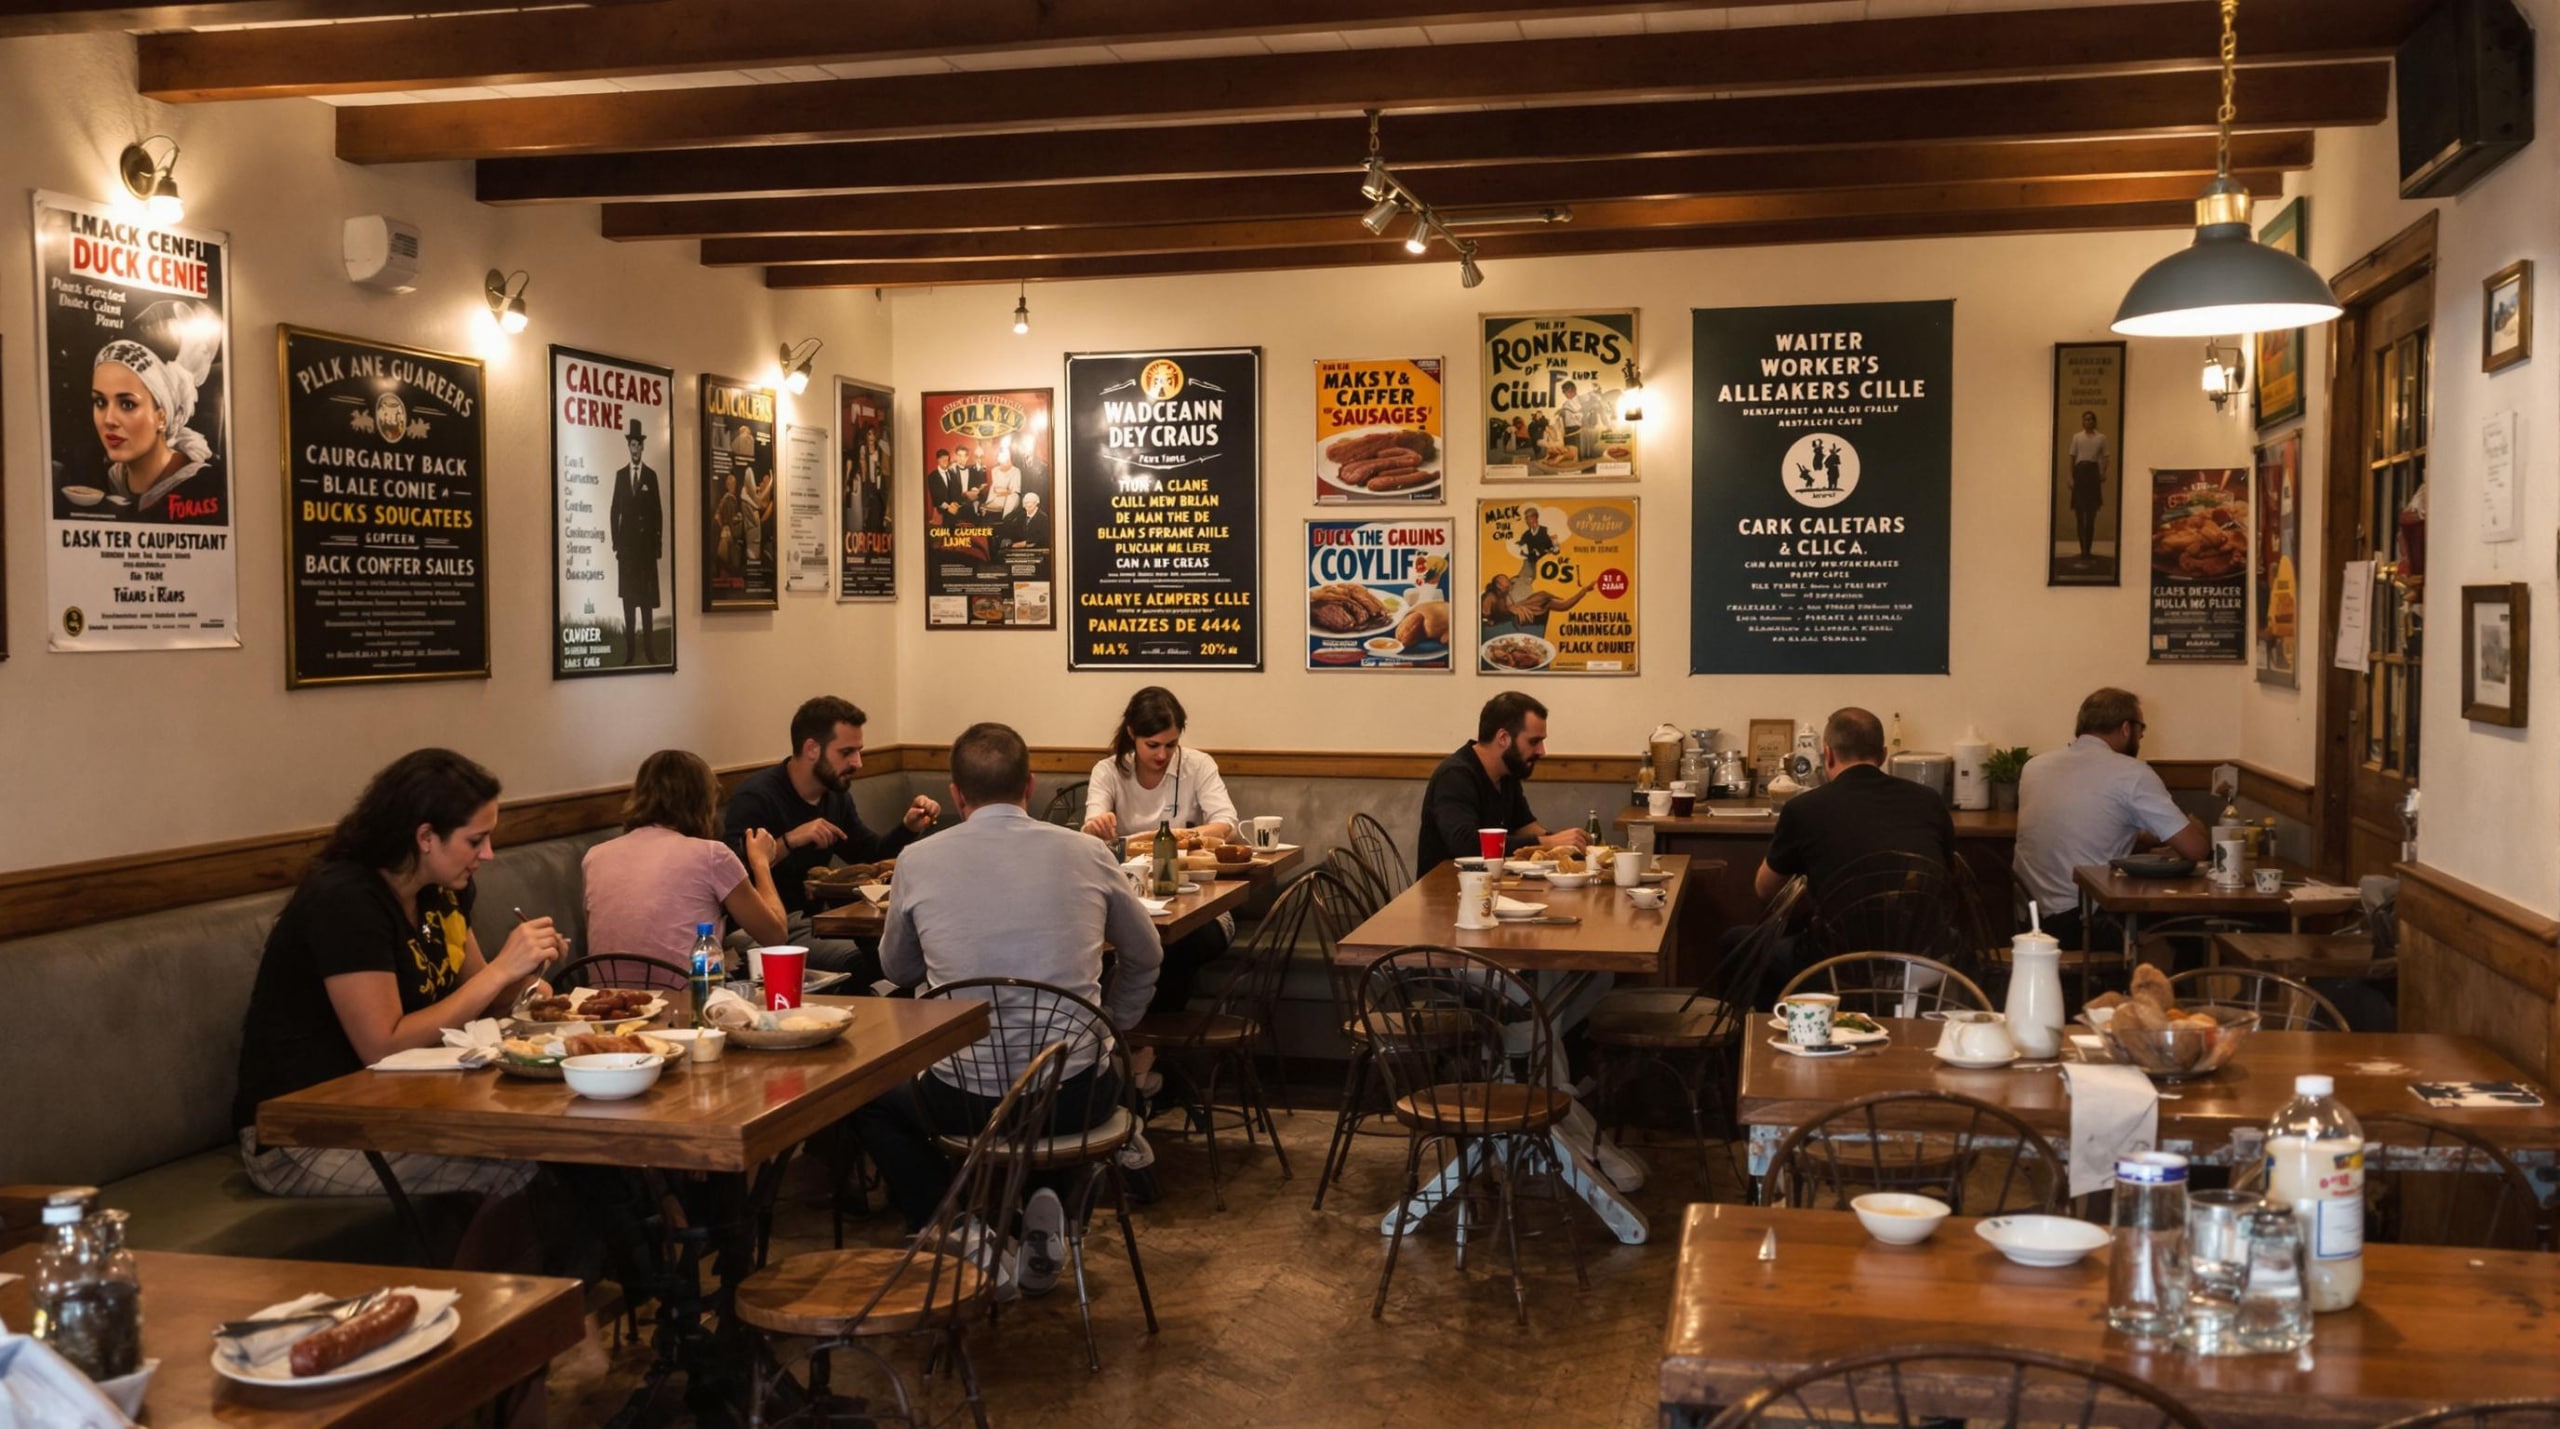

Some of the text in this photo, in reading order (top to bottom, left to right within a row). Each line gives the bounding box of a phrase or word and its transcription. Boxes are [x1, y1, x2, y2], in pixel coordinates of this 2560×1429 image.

[74, 237, 207, 294] DUCK CENIE
[1775, 332, 1863, 351] WAITER
[1492, 331, 1621, 375] RONKERS
[351, 355, 384, 377] ANE
[1760, 356, 1880, 377] WORKER'S
[566, 363, 662, 406] CALCEARS
[1718, 380, 1925, 402] ALLEAKERS CILLE
[1336, 388, 1414, 406] CAFFER
[564, 396, 623, 430] CERNE
[1104, 400, 1222, 423] WADCEANN
[1109, 424, 1219, 448] DEY CRAUS
[422, 455, 467, 477] BACK
[383, 480, 437, 500] CONIE
[303, 500, 473, 528] BUCKS SOUCATEES
[1116, 511, 1210, 523] DE MAN THE DE
[1738, 517, 1905, 535] CARK CALETARS
[105, 531, 132, 548] TER
[1313, 528, 1354, 546] DUCK
[1358, 530, 1383, 545] THE
[305, 555, 350, 574] BACK
[425, 558, 475, 576] SAILES
[1116, 558, 1139, 568] CAN
[1175, 618, 1197, 632] DE
